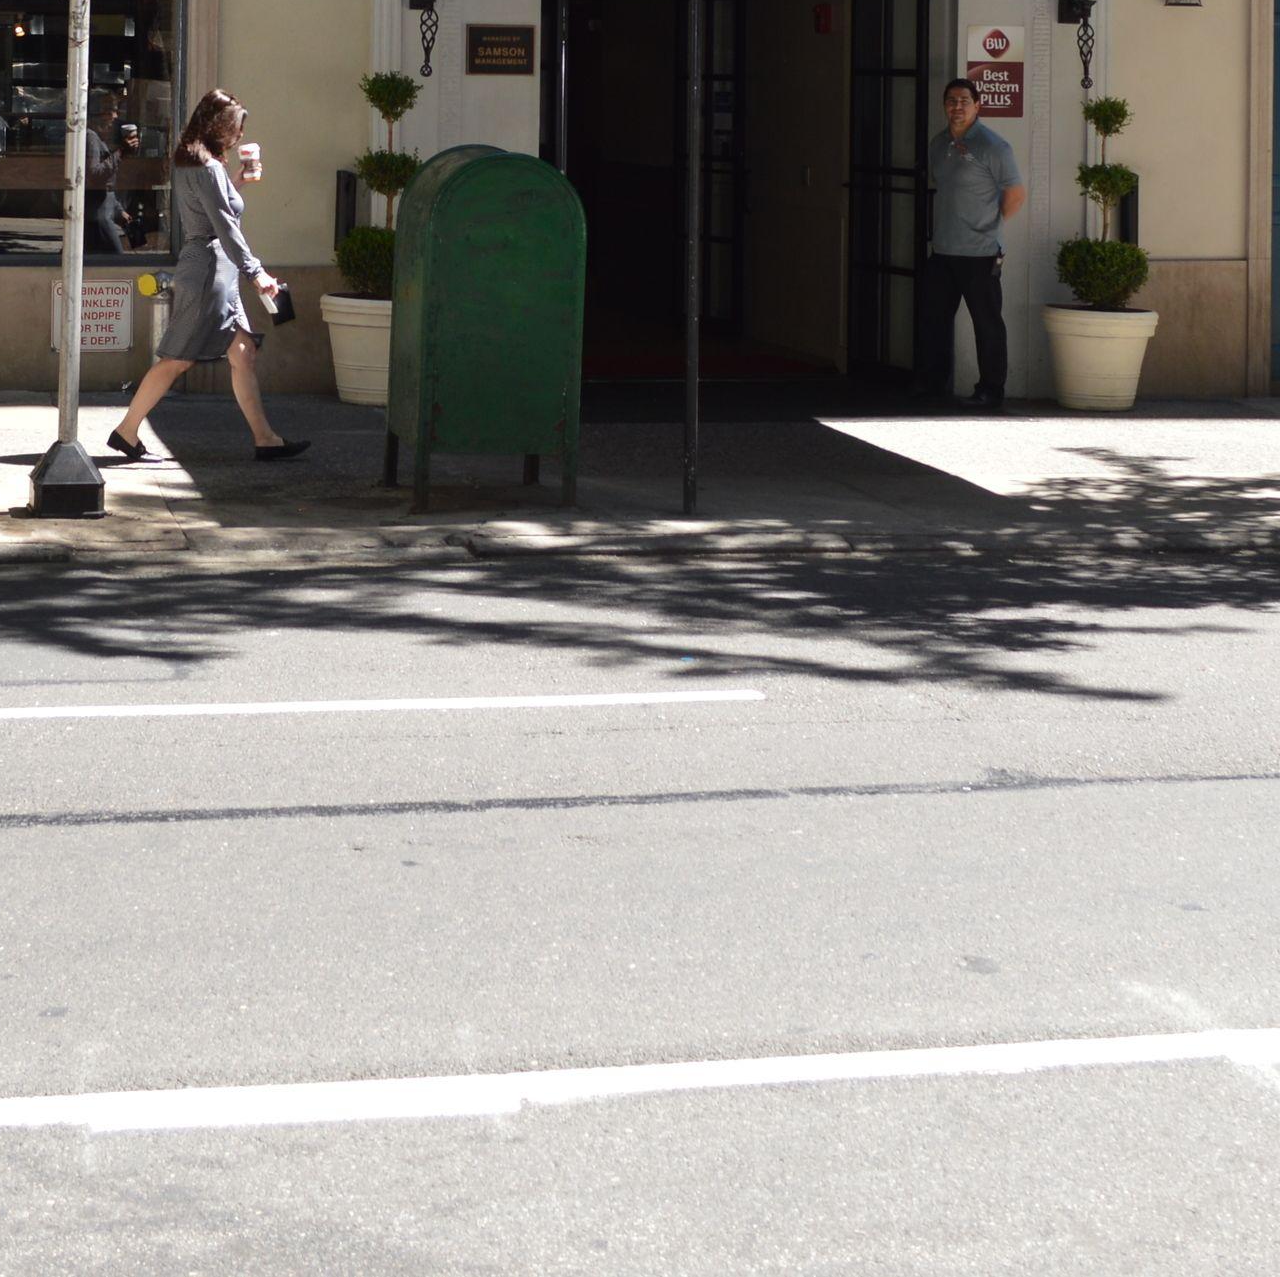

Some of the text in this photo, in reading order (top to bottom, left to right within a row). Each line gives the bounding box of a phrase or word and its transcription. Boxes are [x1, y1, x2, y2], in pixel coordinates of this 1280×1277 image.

[986, 38, 1007, 51] BW
[478, 46, 526, 57] SAMSON
[983, 70, 1009, 81] Best
[973, 81, 1020, 93] Western
[980, 94, 1012, 106] PLUS
[56, 286, 129, 296] CBINATION
[81, 299, 124, 308] INKLER/
[80, 311, 121, 320] NDPIPE
[95, 324, 115, 333] THE
[91, 336, 120, 345] DEPT.
